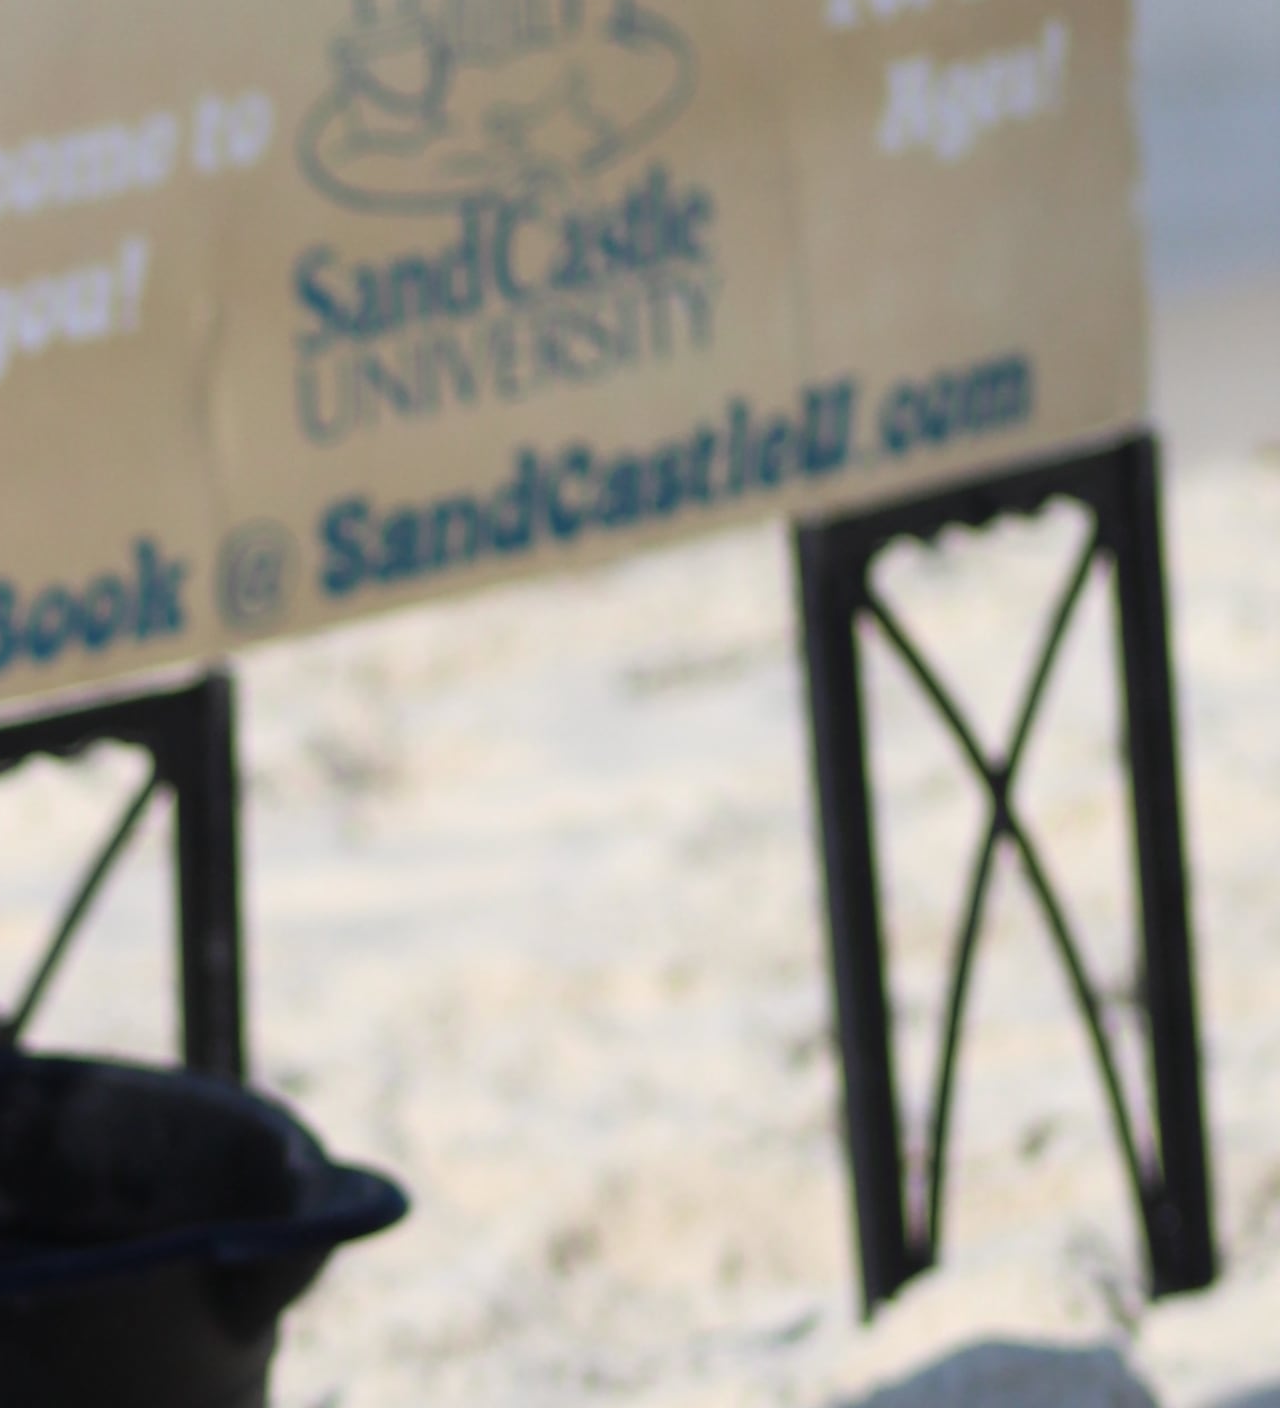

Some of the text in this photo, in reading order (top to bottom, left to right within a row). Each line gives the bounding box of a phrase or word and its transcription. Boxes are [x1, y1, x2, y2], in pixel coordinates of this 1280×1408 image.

[192, 88, 274, 174] to
[877, 16, 1069, 163] Ages!
[296, 277, 720, 446] UNIVERSITY
[218, 519, 299, 631] @
